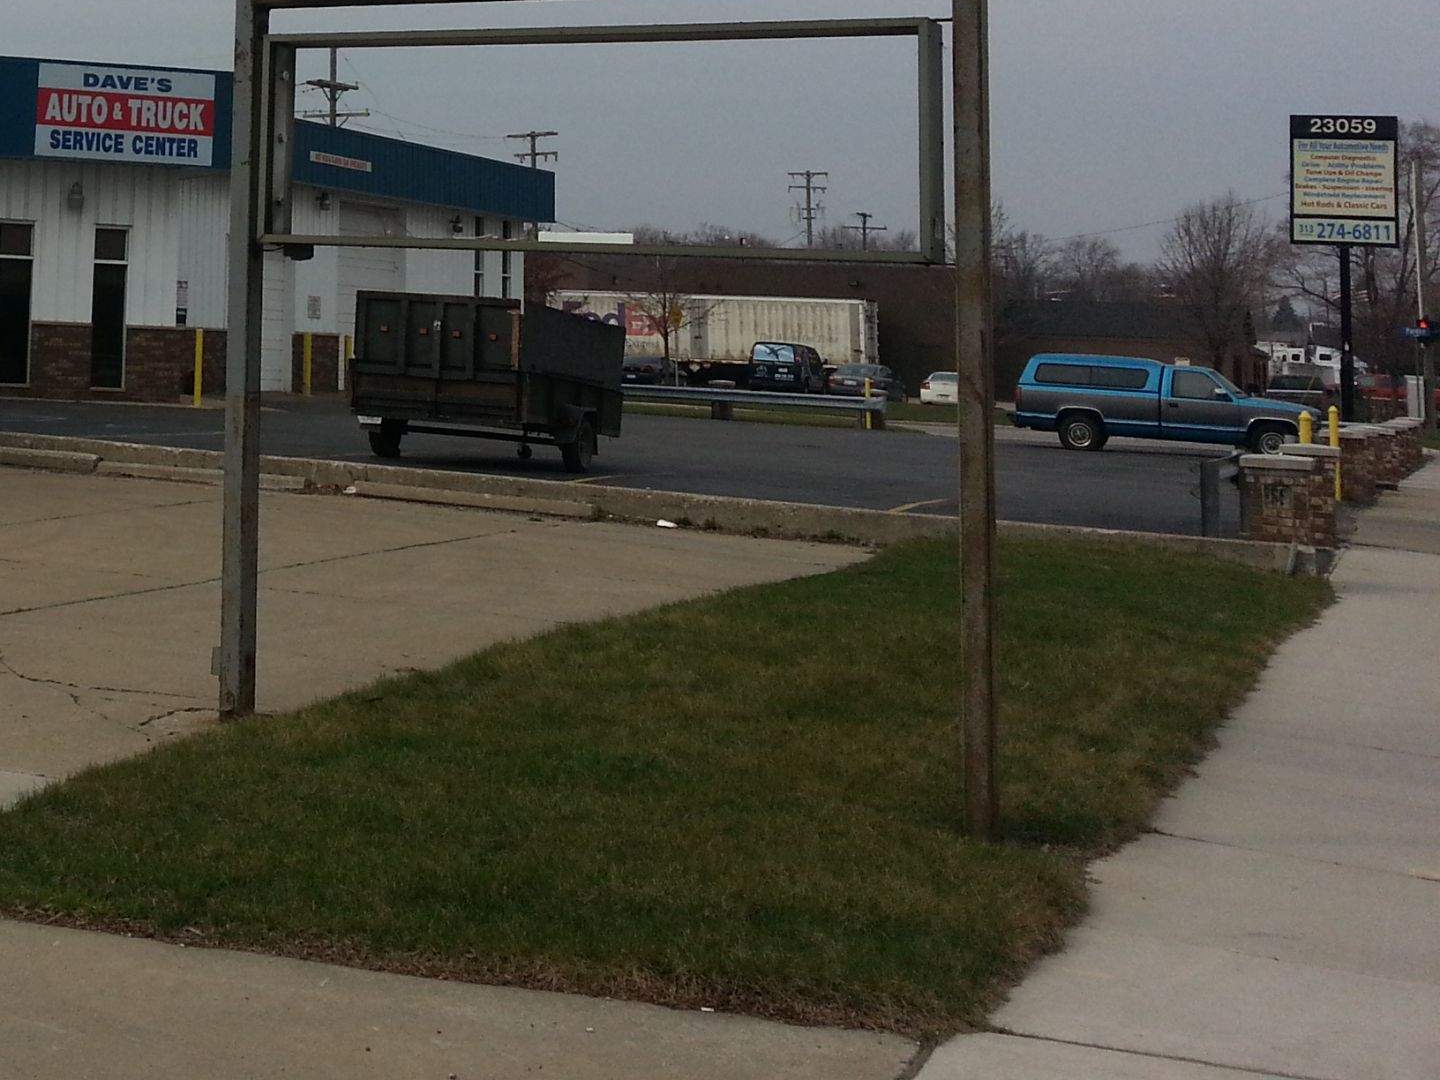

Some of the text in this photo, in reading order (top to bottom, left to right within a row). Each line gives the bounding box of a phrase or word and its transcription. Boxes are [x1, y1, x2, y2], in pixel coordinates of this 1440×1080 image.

[83, 73, 172, 93] DAVE'S
[45, 92, 205, 131] AUTO & TRUCK
[1310, 118, 1377, 134] 23059
[50, 129, 198, 159] SERVICE CENTER
[1343, 201, 1369, 210] Classic
[1370, 202, 1388, 210] Cars
[1299, 223, 1391, 241] 313 274-6811
